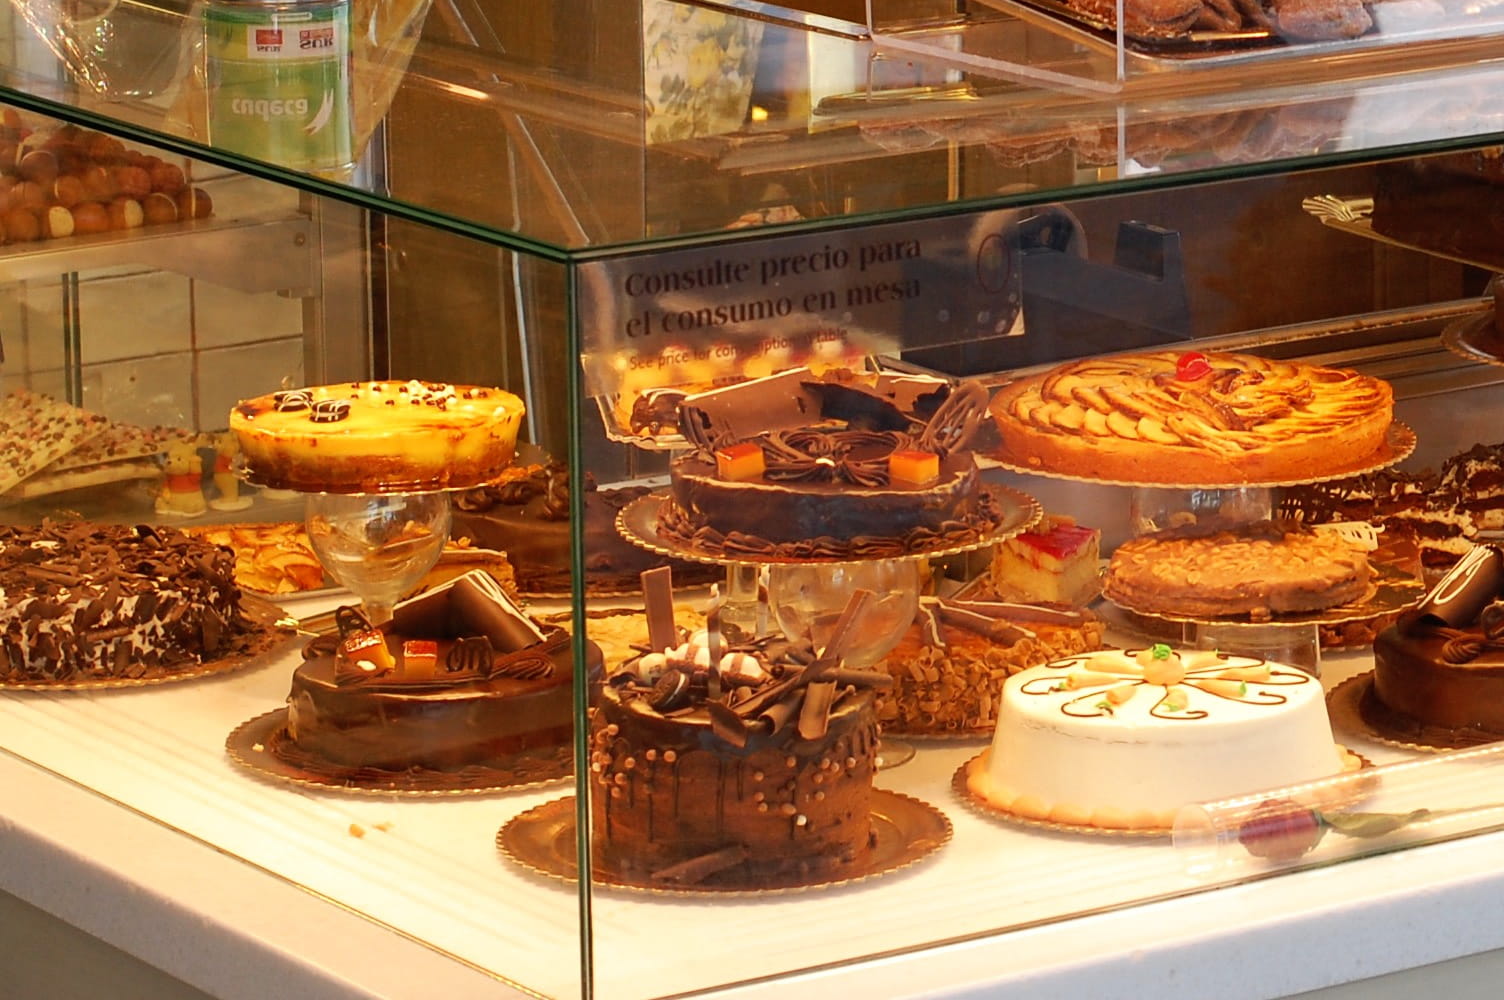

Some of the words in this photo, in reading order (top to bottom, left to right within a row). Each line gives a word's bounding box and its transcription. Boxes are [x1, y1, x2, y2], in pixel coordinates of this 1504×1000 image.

[625, 258, 750, 298] Consulte
[760, 244, 849, 285] precio
[859, 238, 921, 272] para
[626, 312, 651, 337] el
[661, 297, 792, 330] consumo
[803, 289, 837, 313] en
[847, 279, 921, 307] mesa
[629, 355, 652, 371] See
[658, 348, 689, 369] price
[816, 327, 848, 343] table
